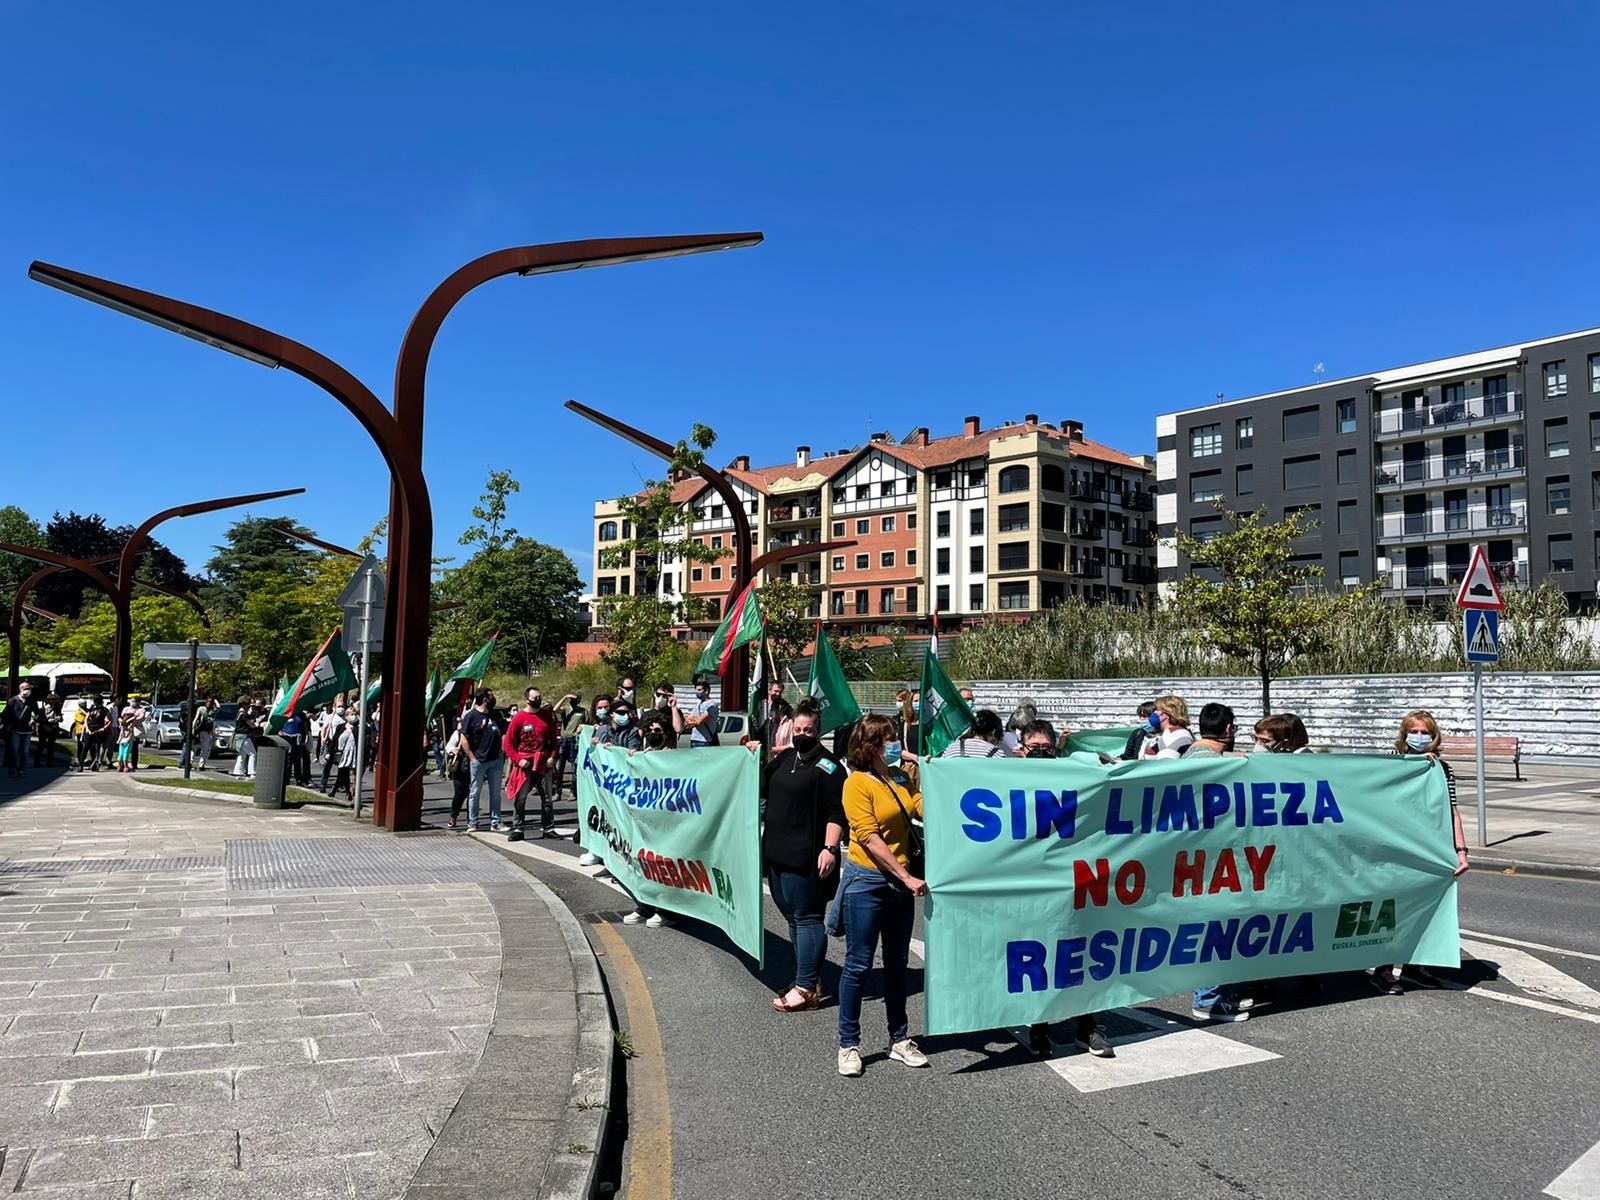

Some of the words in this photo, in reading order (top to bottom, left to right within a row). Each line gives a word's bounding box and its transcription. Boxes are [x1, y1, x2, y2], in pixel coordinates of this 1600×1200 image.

[628, 776, 702, 815] EGOITZAN
[959, 787, 1079, 843] SIN
[1104, 779, 1345, 836] LIMPIEZA
[1073, 858, 1146, 910] NO
[1172, 844, 1277, 898] HAY
[1334, 898, 1396, 939] ELA
[1006, 911, 1315, 995] RESIDENCIA
